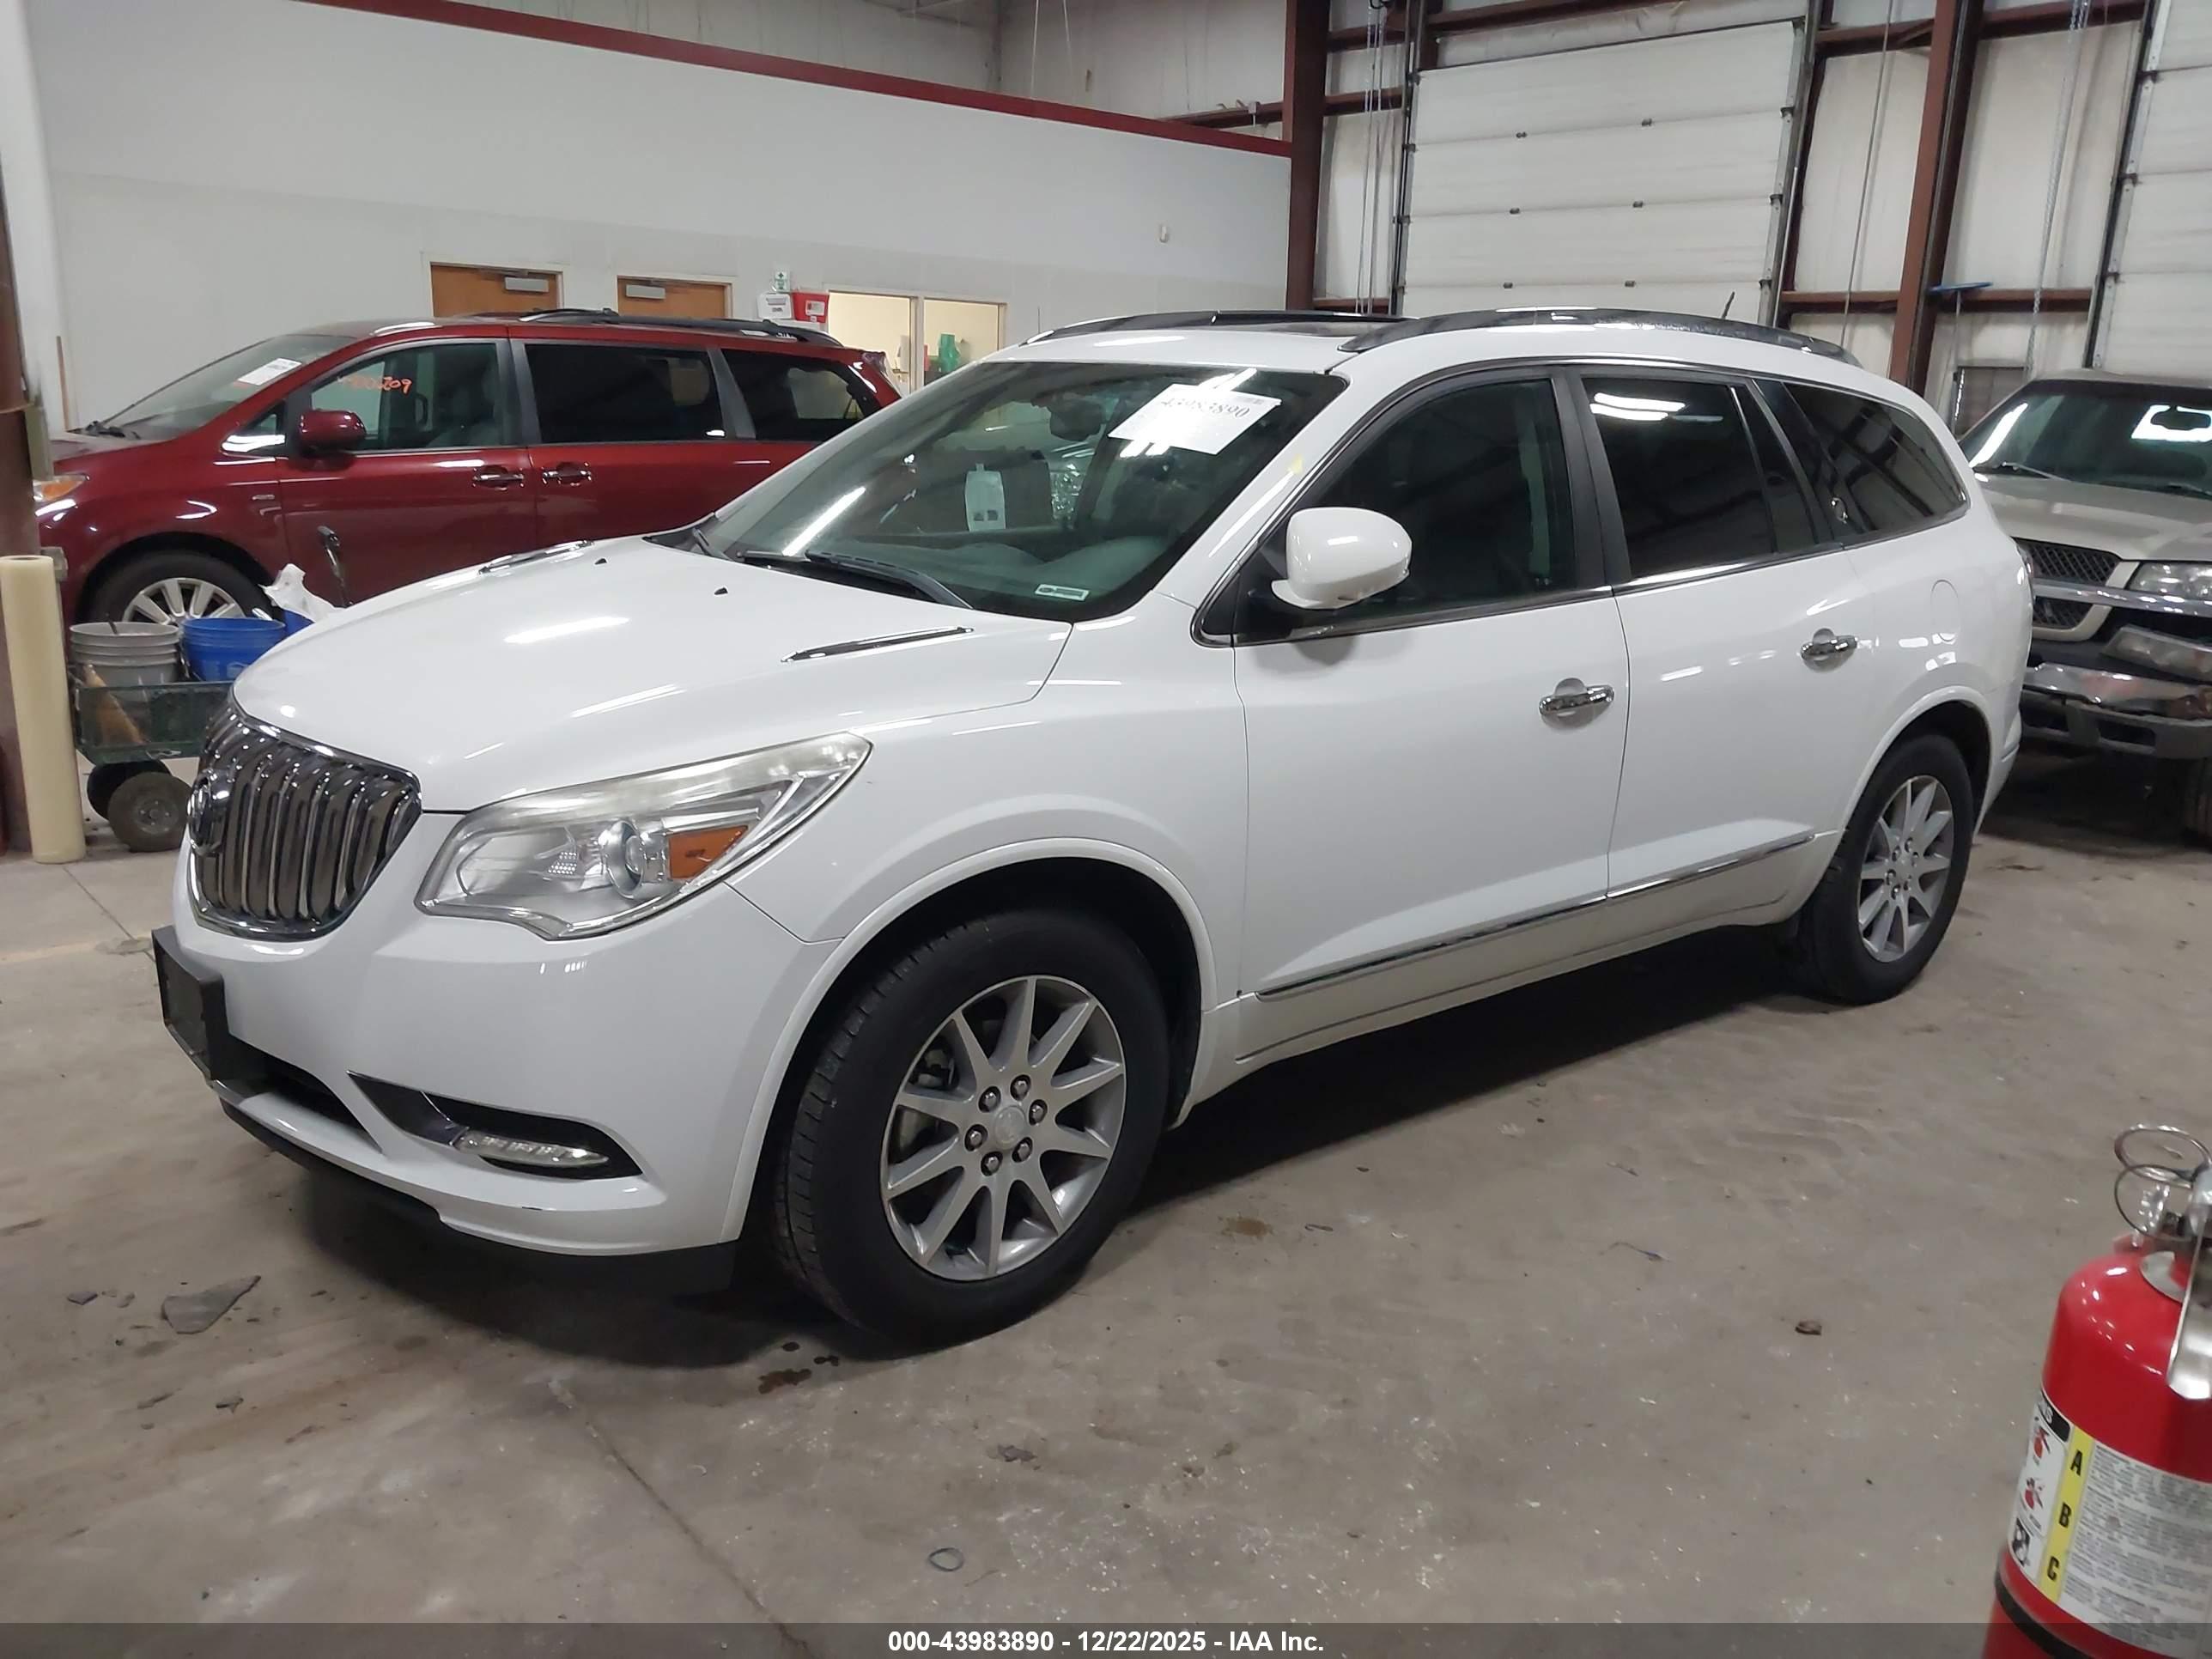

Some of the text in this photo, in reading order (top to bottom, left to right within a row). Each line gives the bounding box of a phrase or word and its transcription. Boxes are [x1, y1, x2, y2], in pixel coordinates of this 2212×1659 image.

[2070, 1449, 2083, 1476] A
[2058, 1501, 2072, 1528] B
[2047, 1556, 2060, 1581] C
